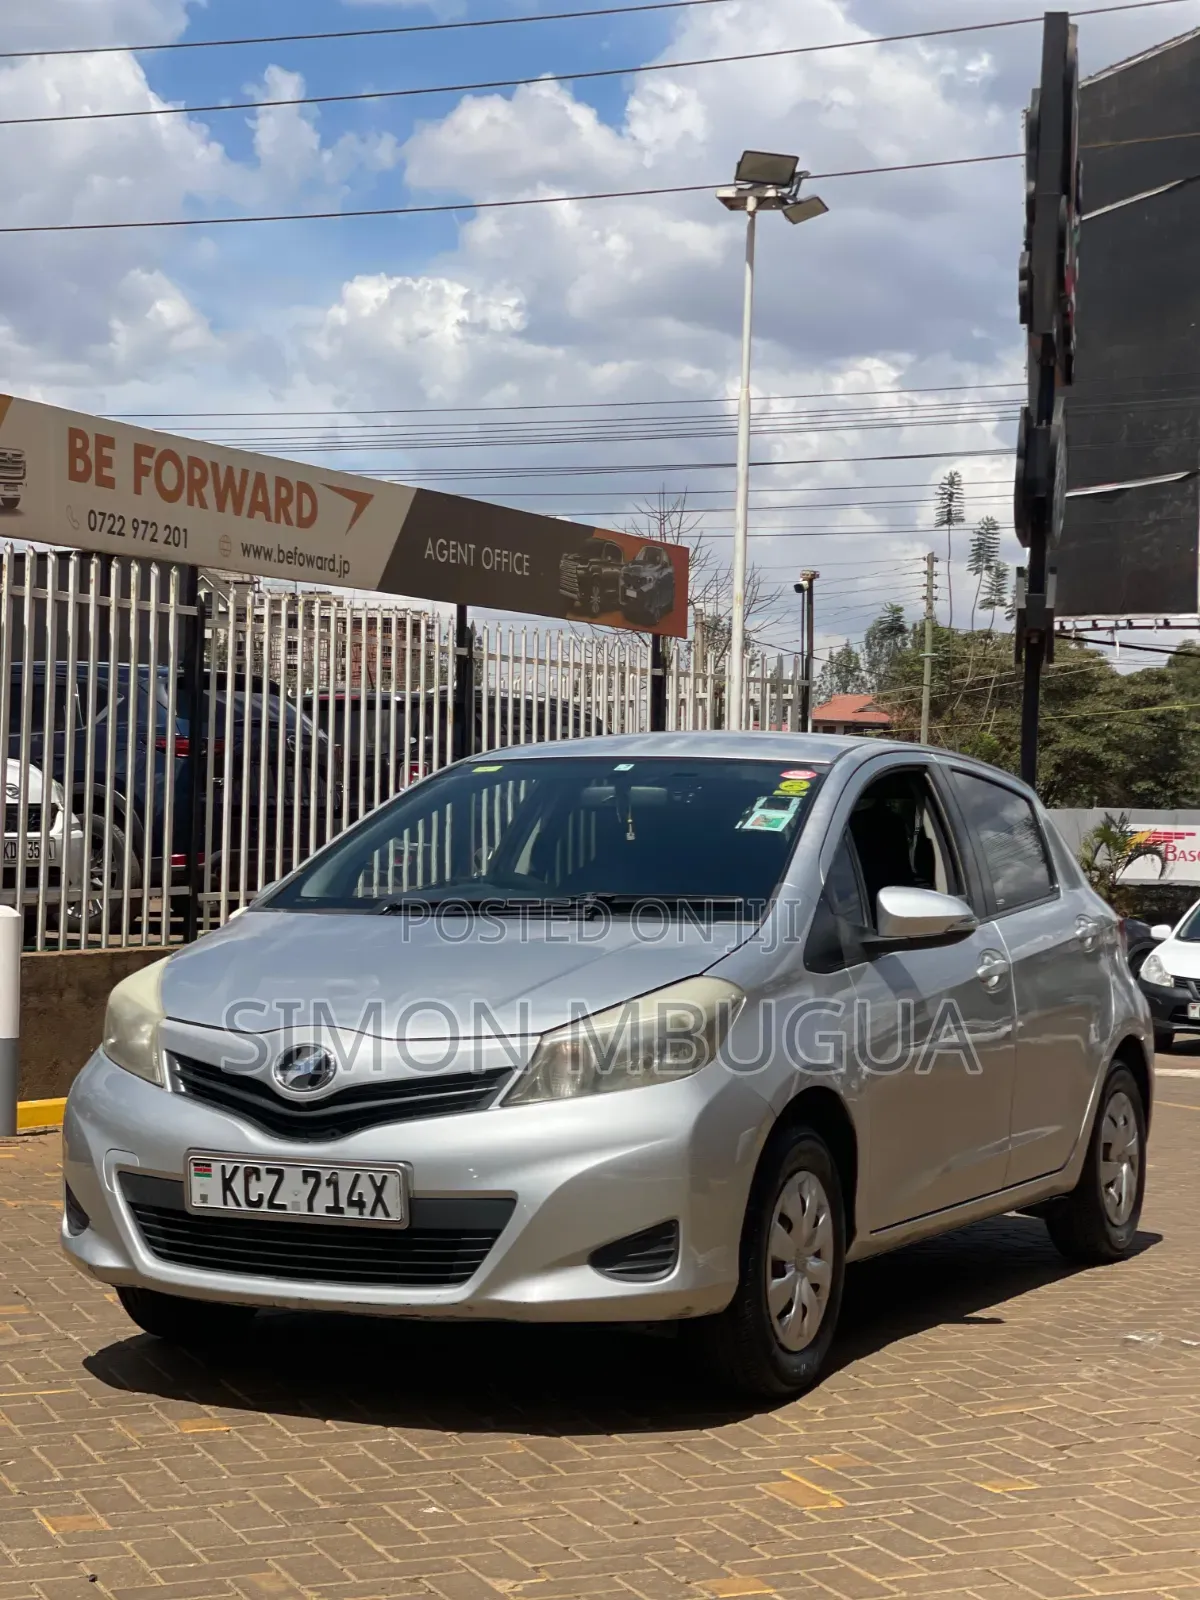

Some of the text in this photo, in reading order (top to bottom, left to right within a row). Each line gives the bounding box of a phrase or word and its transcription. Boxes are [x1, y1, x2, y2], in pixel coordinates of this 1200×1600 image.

[68, 426, 318, 529] BE FORWARD
[87, 509, 188, 549] 0722 972 201
[241, 541, 350, 578] www.befoward.jp
[424, 537, 530, 576] AGENT OFFICE
[221, 1164, 391, 1218] KCZ 714X
